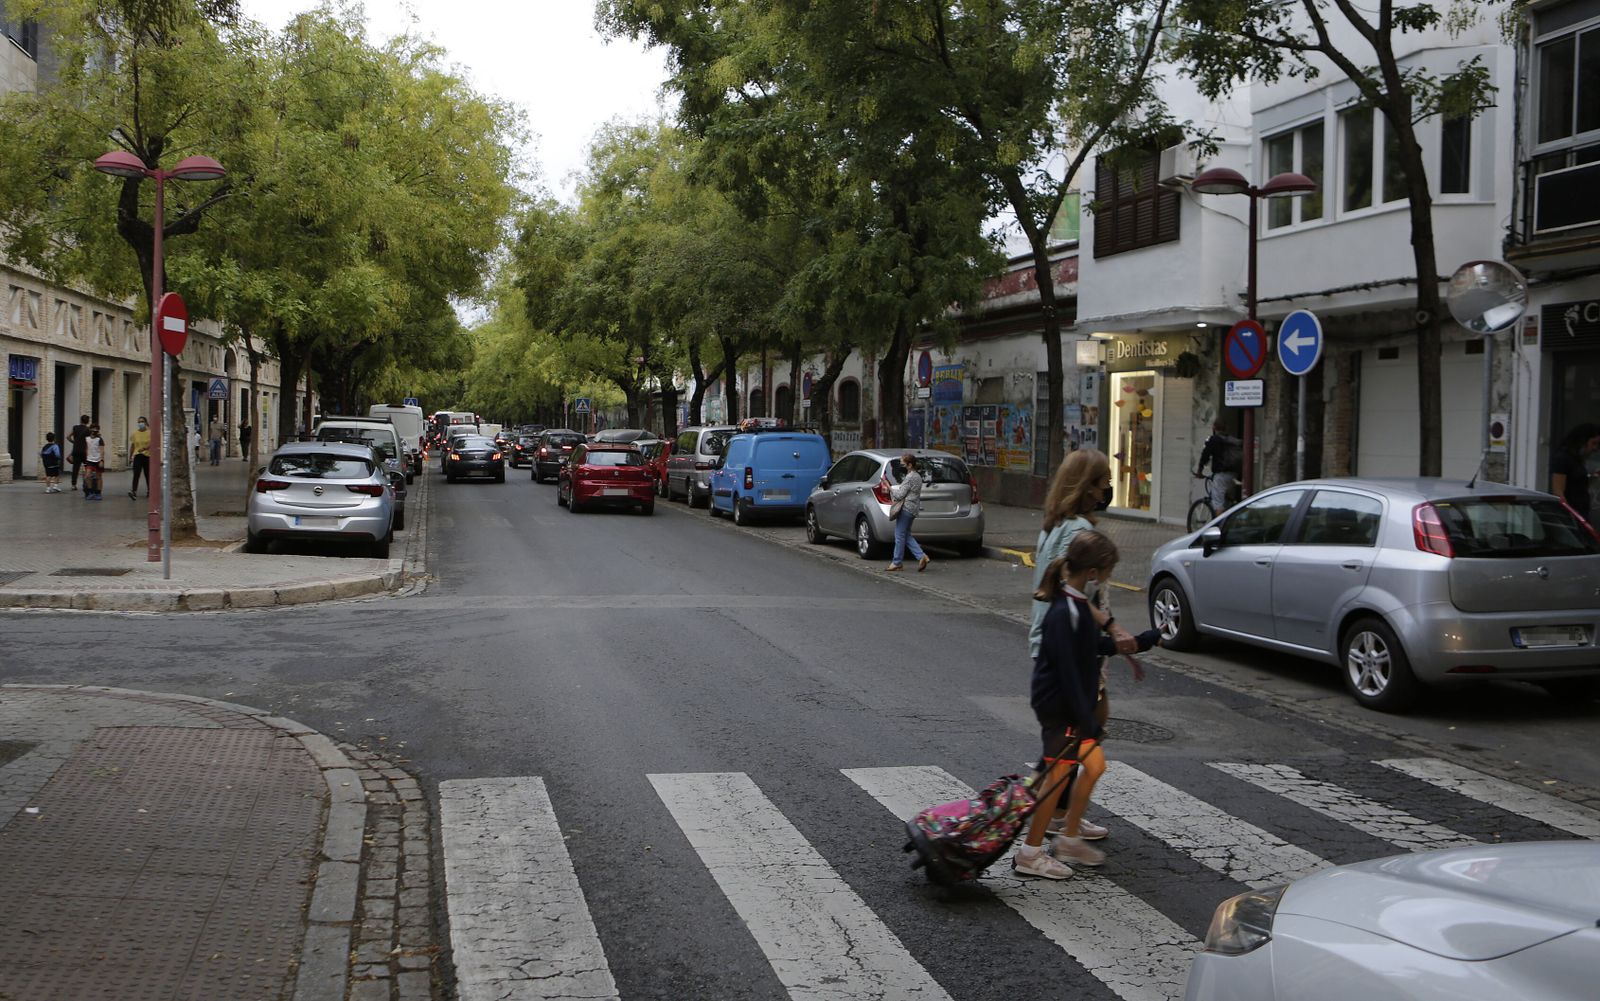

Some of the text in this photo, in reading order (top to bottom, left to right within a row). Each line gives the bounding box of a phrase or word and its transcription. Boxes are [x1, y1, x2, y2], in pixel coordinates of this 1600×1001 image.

[1117, 340, 1168, 359] Dentistas
[9, 357, 36, 380] ALDI
[935, 368, 964, 385] BERLIN
